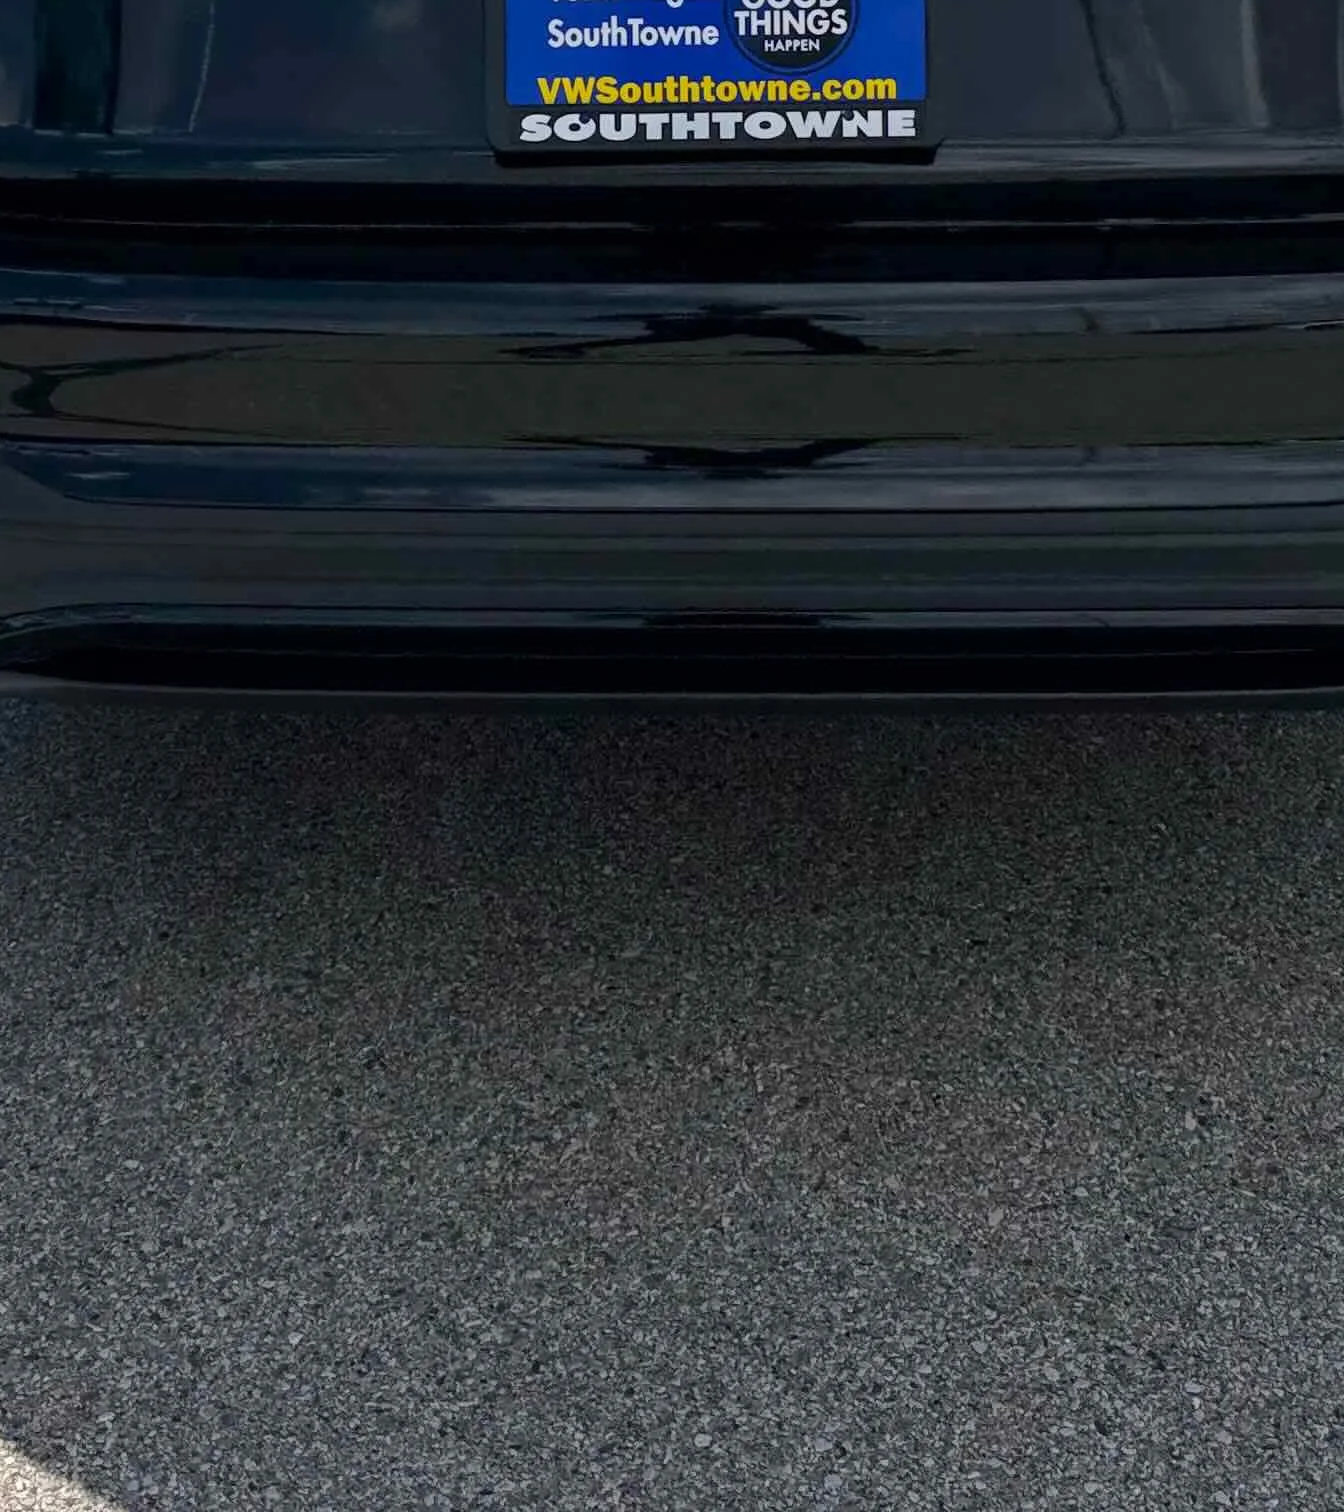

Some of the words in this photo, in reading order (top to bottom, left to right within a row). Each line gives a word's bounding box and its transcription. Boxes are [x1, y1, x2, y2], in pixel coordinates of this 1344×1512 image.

[547, 15, 719, 48] SouthTowne
[733, 8, 848, 36] THINGS
[764, 38, 820, 52] HAPPEN
[537, 76, 897, 105] VWSouthtowne.com
[519, 109, 916, 143] SOUTHTOWNE
